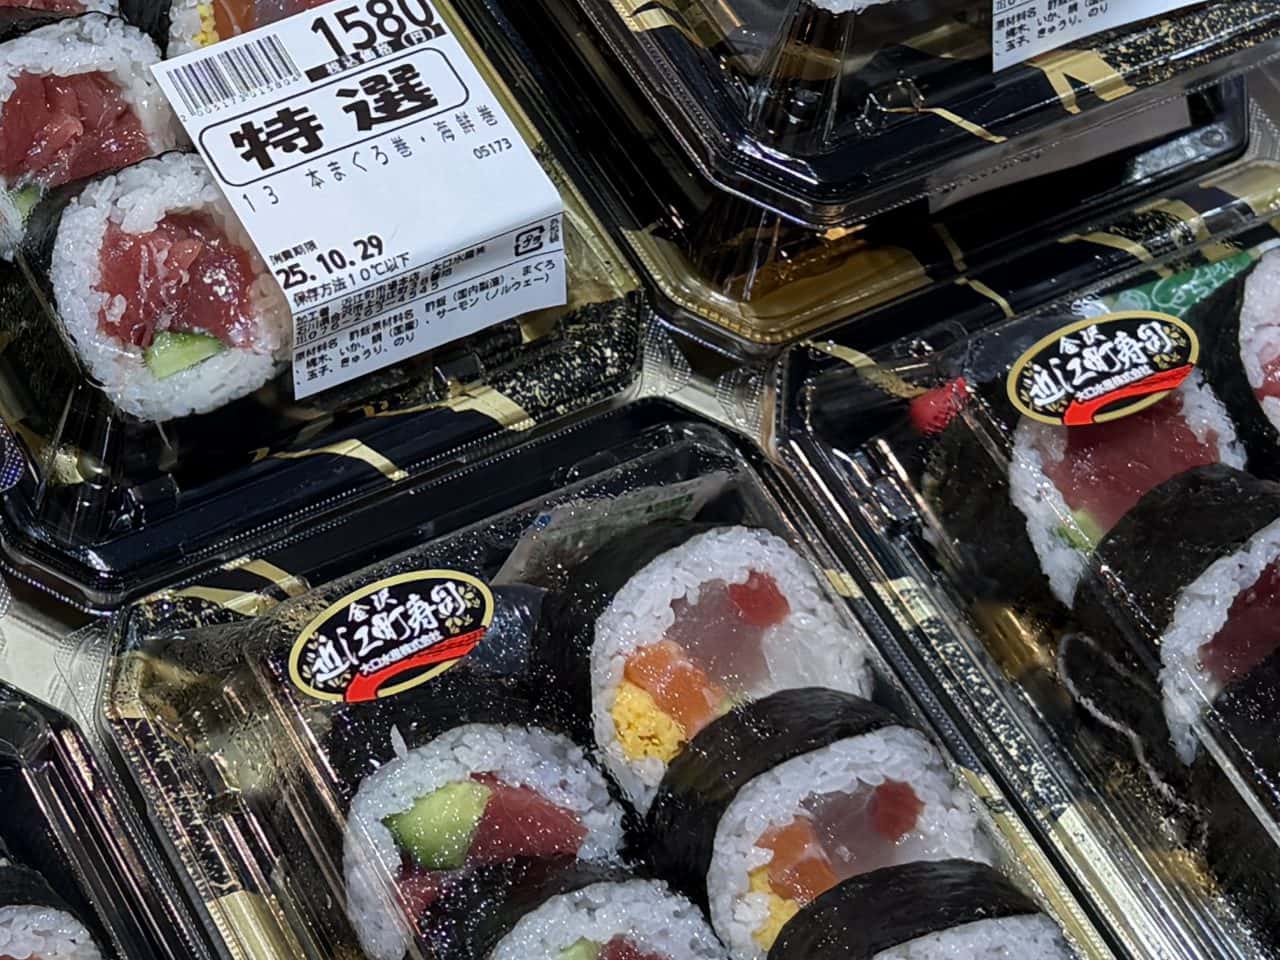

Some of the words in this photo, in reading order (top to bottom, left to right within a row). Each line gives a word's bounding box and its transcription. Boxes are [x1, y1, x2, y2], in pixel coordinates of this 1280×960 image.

[230, 64, 439, 171] 特選
[473, 137, 513, 159] 05173
[242, 185, 279, 213] 13
[1059, 325, 1107, 355] 金沢
[1029, 321, 1172, 406] 近江町寿司
[348, 588, 398, 622] 金沢
[312, 581, 466, 683] 近江町寿司
